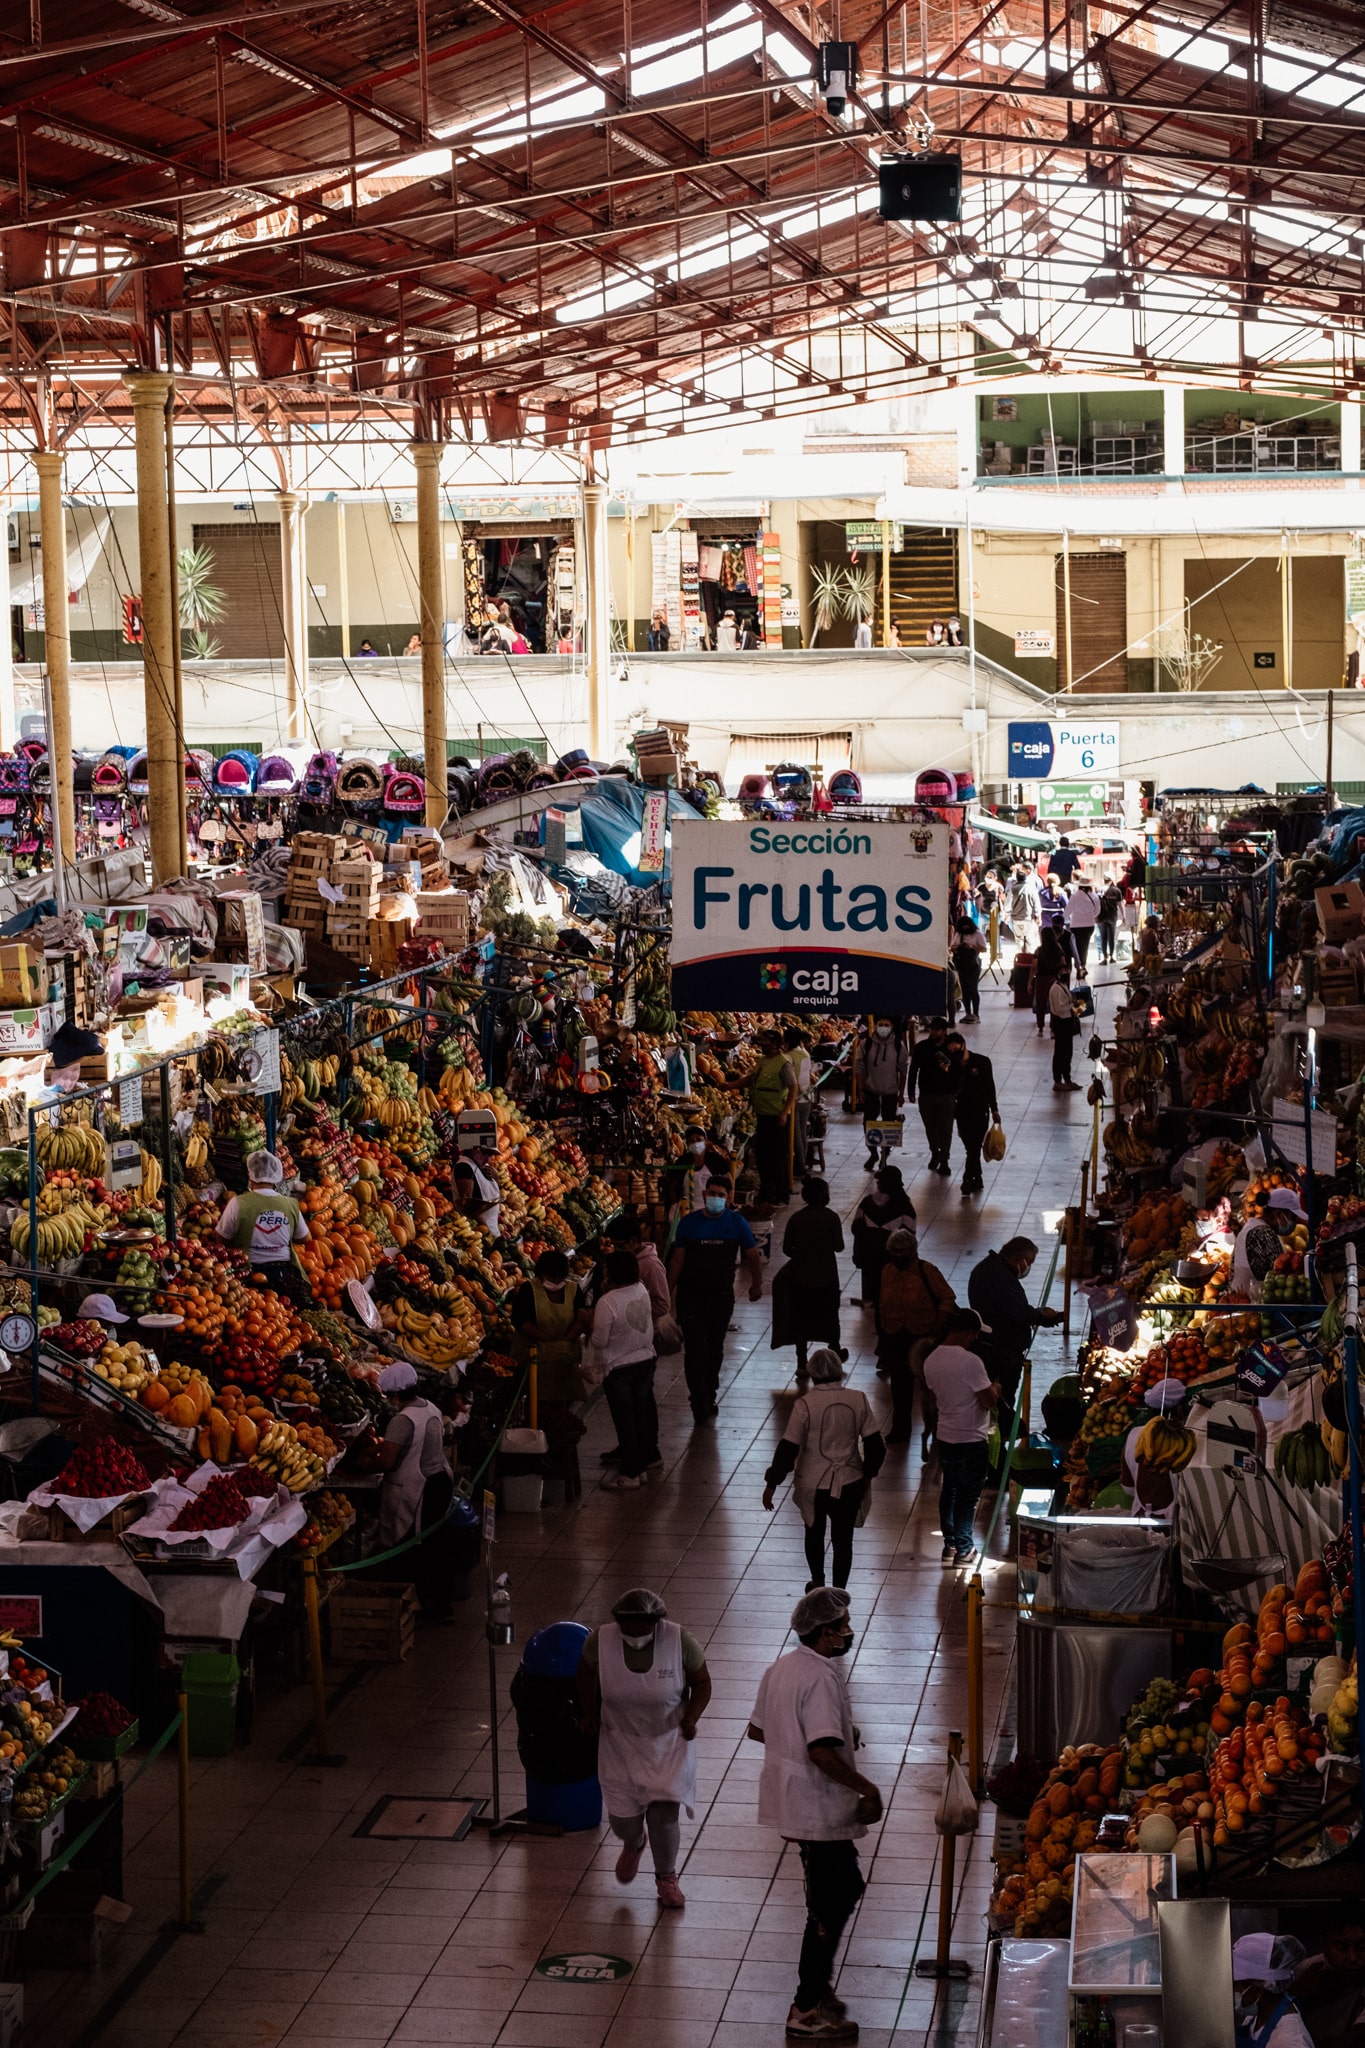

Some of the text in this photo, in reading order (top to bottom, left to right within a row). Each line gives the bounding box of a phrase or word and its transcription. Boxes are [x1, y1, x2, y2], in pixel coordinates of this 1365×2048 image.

[458, 503, 580, 517] TDA. 14
[1060, 731, 1116, 745] Puerta
[1023, 741, 1050, 754] caja
[1081, 749, 1095, 768] 6
[648, 798, 661, 853] MECHITA
[749, 826, 872, 854] Sección
[650, 857, 662, 868] 29
[693, 866, 933, 933] Frutas
[792, 963, 859, 996] caja
[792, 995, 839, 1006] arequipa
[1107, 1319, 1128, 1346] yape
[545, 1965, 615, 1980] SIGA
